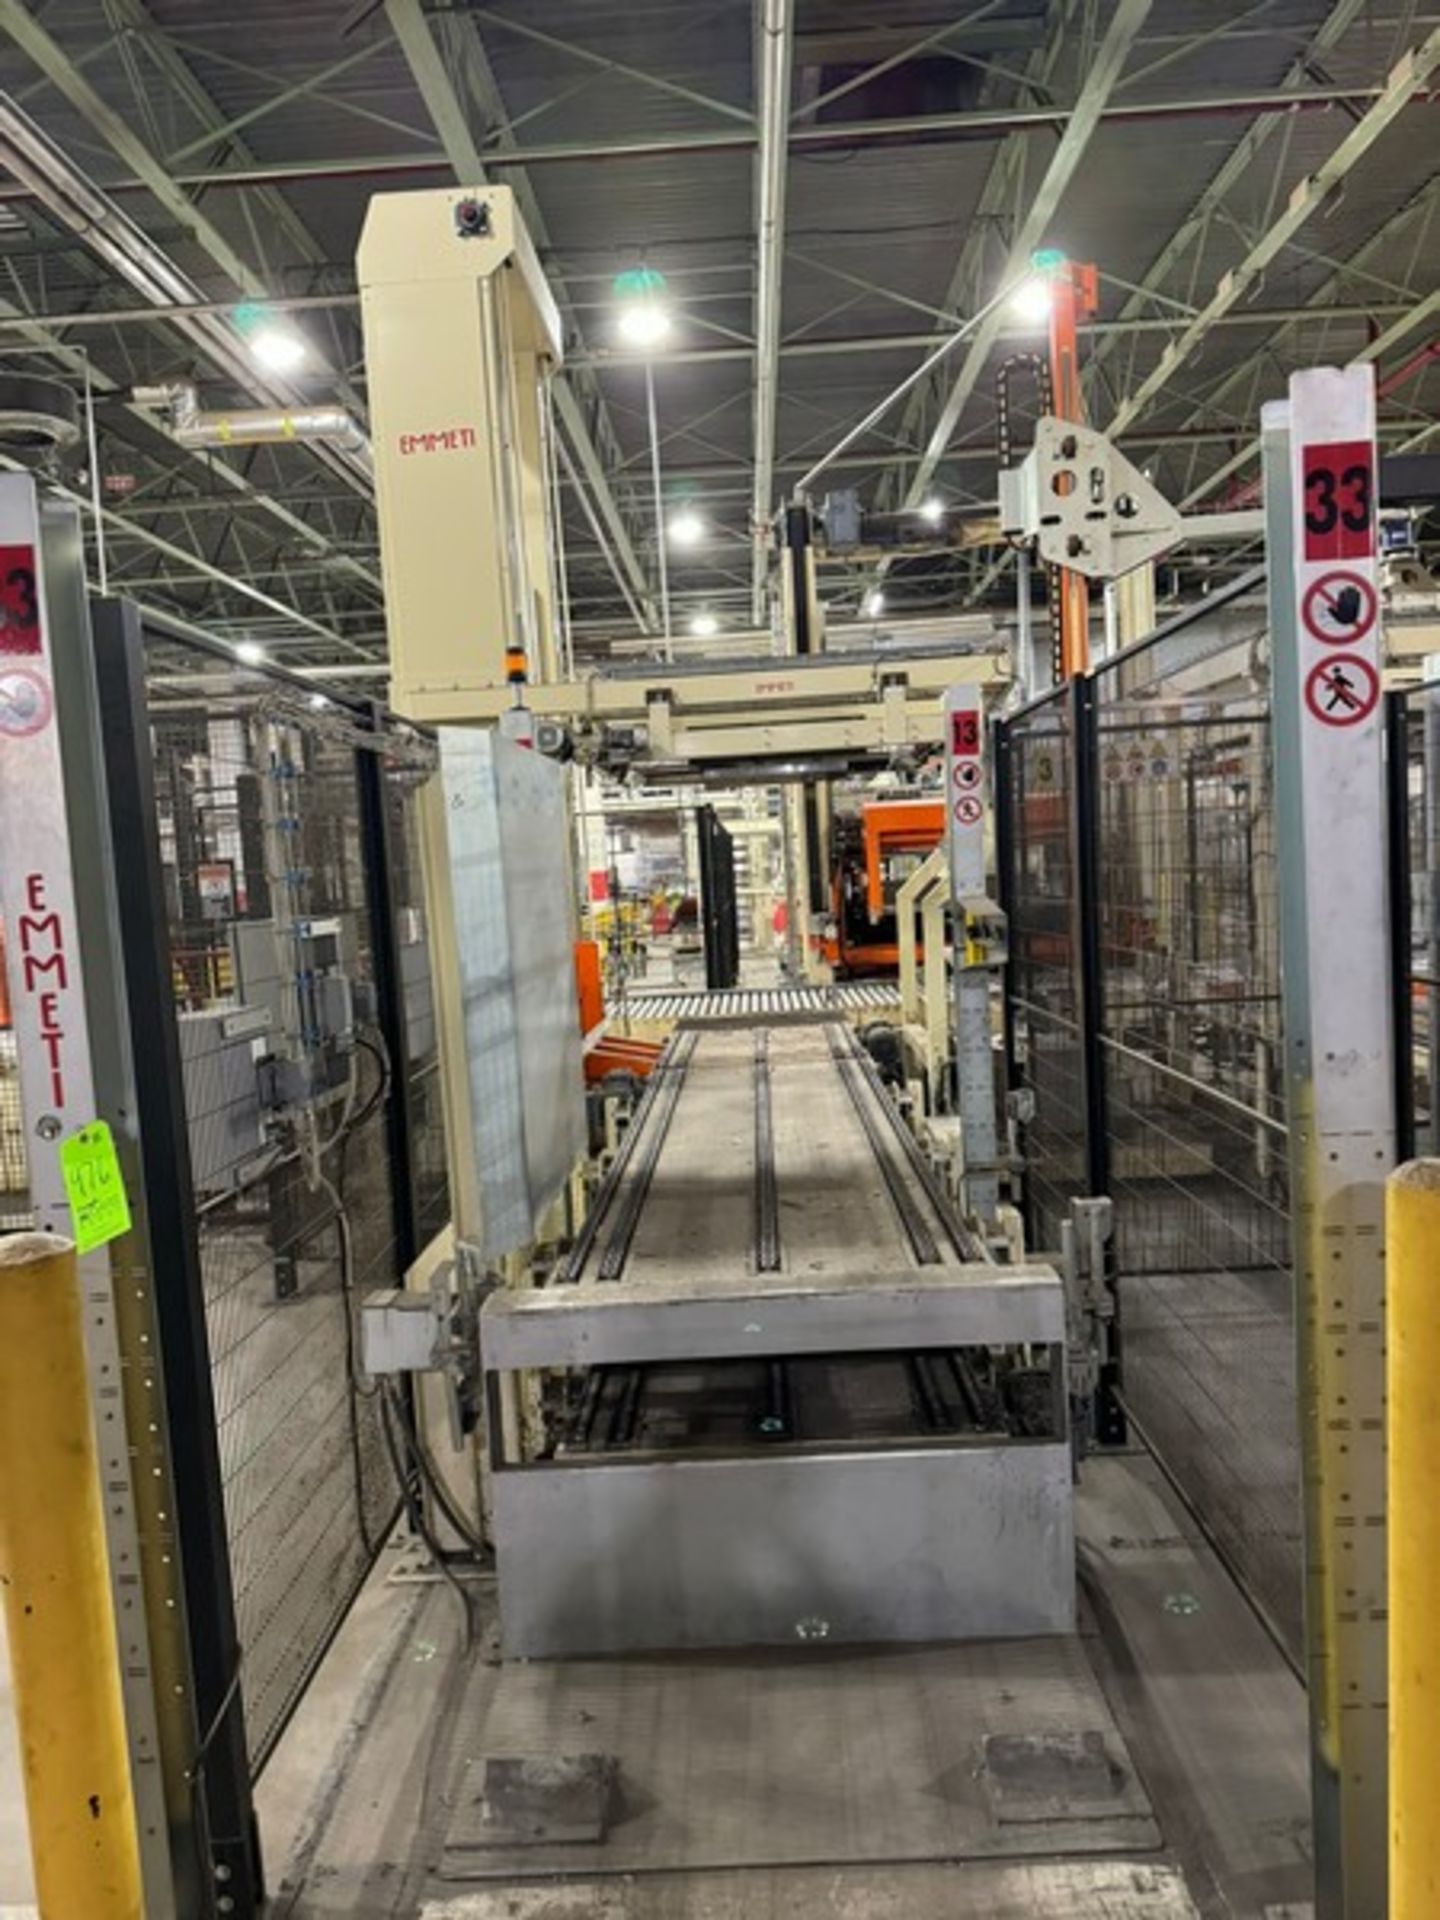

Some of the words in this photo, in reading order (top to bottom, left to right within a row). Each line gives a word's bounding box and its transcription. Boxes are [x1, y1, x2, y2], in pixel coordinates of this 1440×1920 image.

[400, 428, 475, 455] EMMETI
[1305, 465, 1370, 535] 33
[953, 719, 978, 746] 13
[19, 873, 67, 1108] EMMETI
